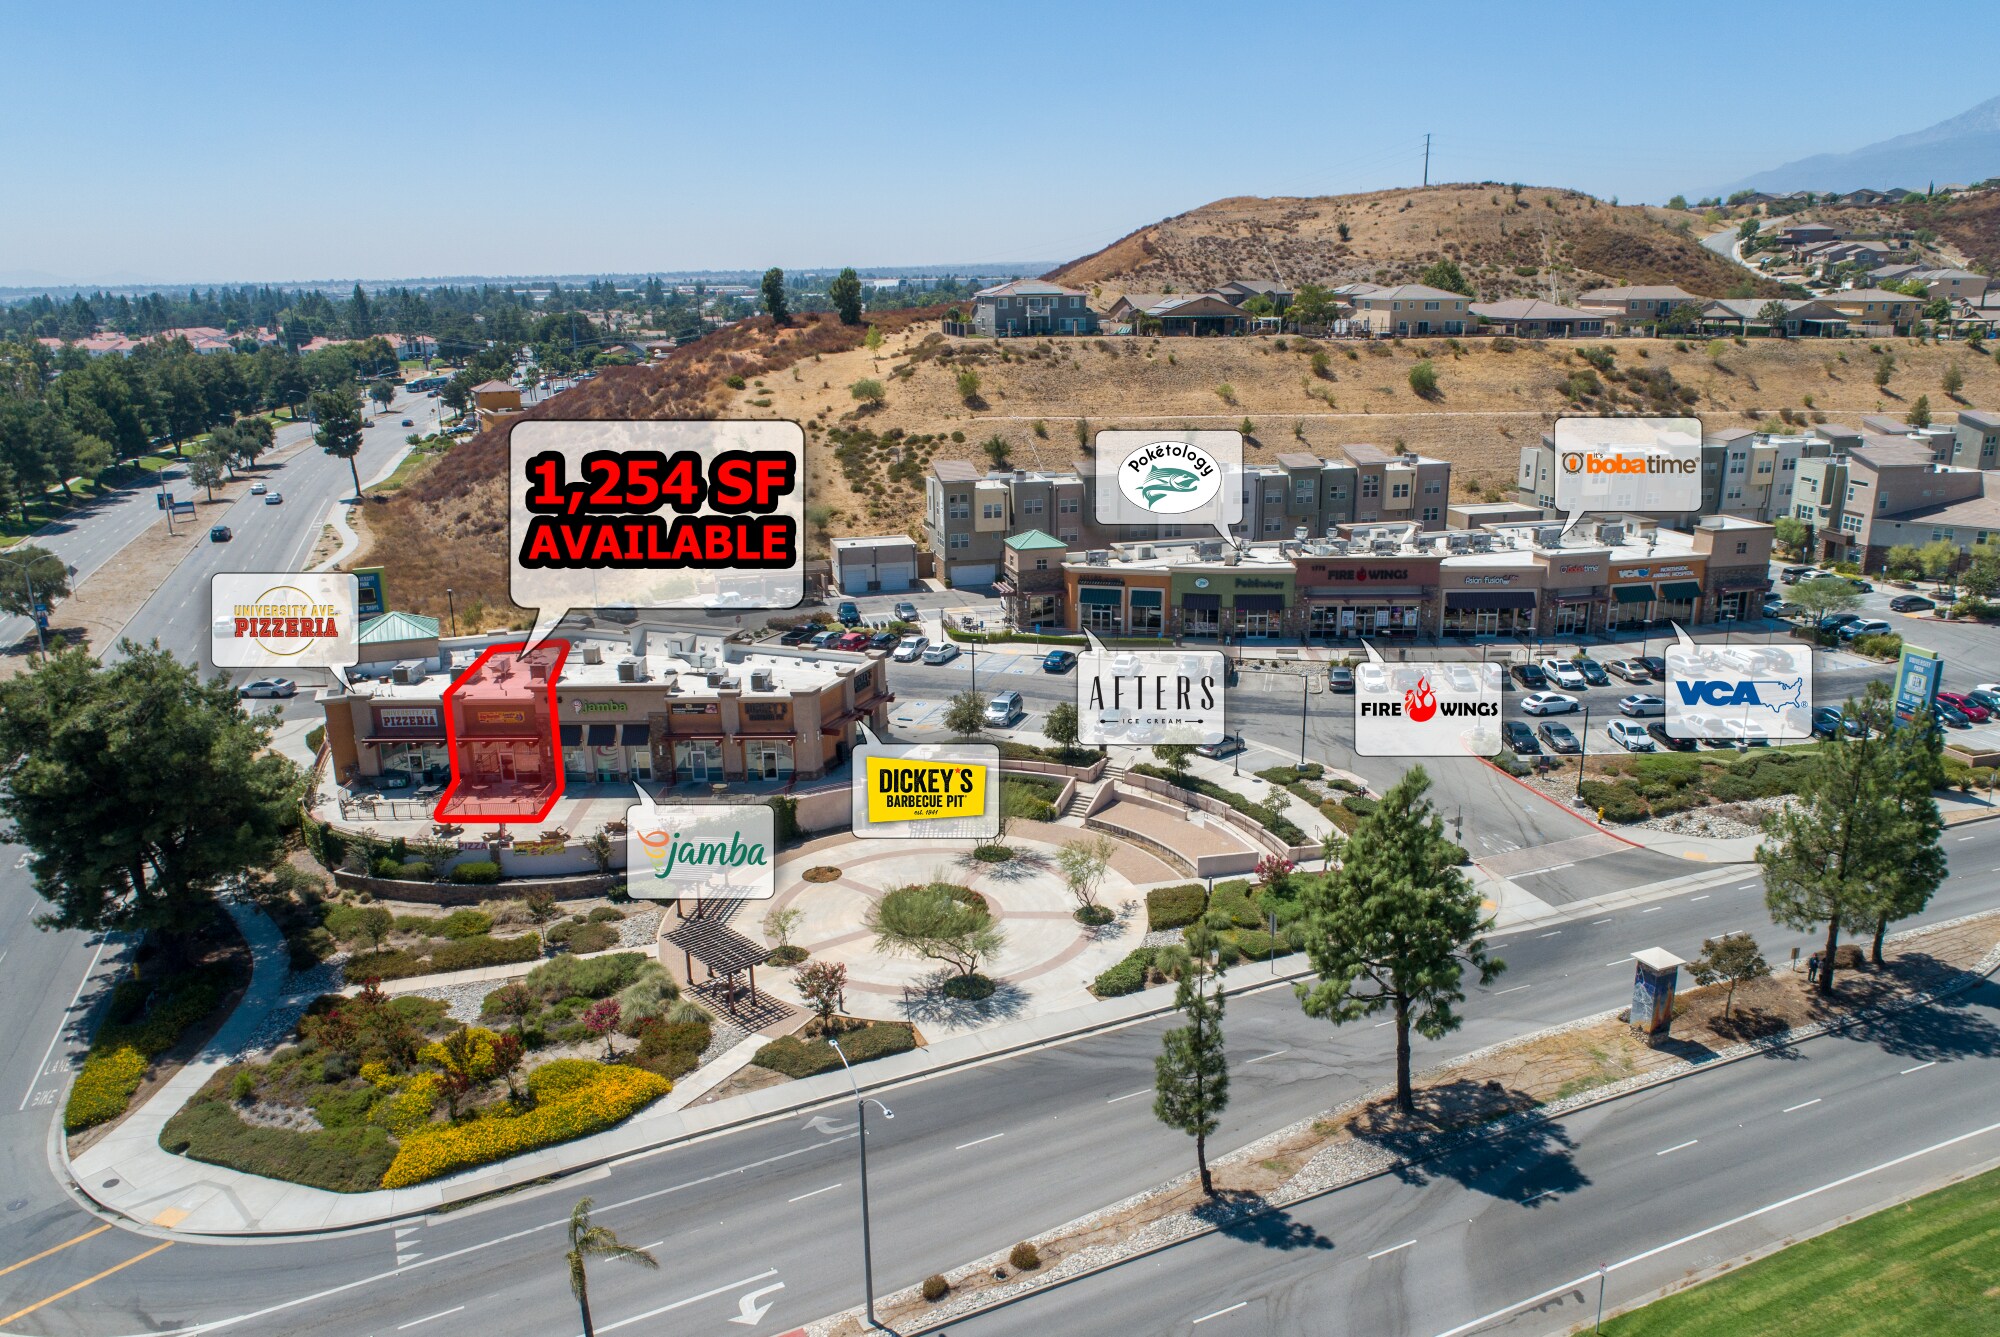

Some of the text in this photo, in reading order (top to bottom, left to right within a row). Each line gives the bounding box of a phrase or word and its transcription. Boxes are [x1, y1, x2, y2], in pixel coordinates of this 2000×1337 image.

[1327, 568, 1408, 581] FIRE WINGS
[1464, 575, 1483, 585] Asian
[1483, 575, 1505, 585] Fusion
[583, 698, 628, 714] jamba
[383, 716, 437, 727] PIZZERIA
[458, 841, 488, 851] PIZZA
